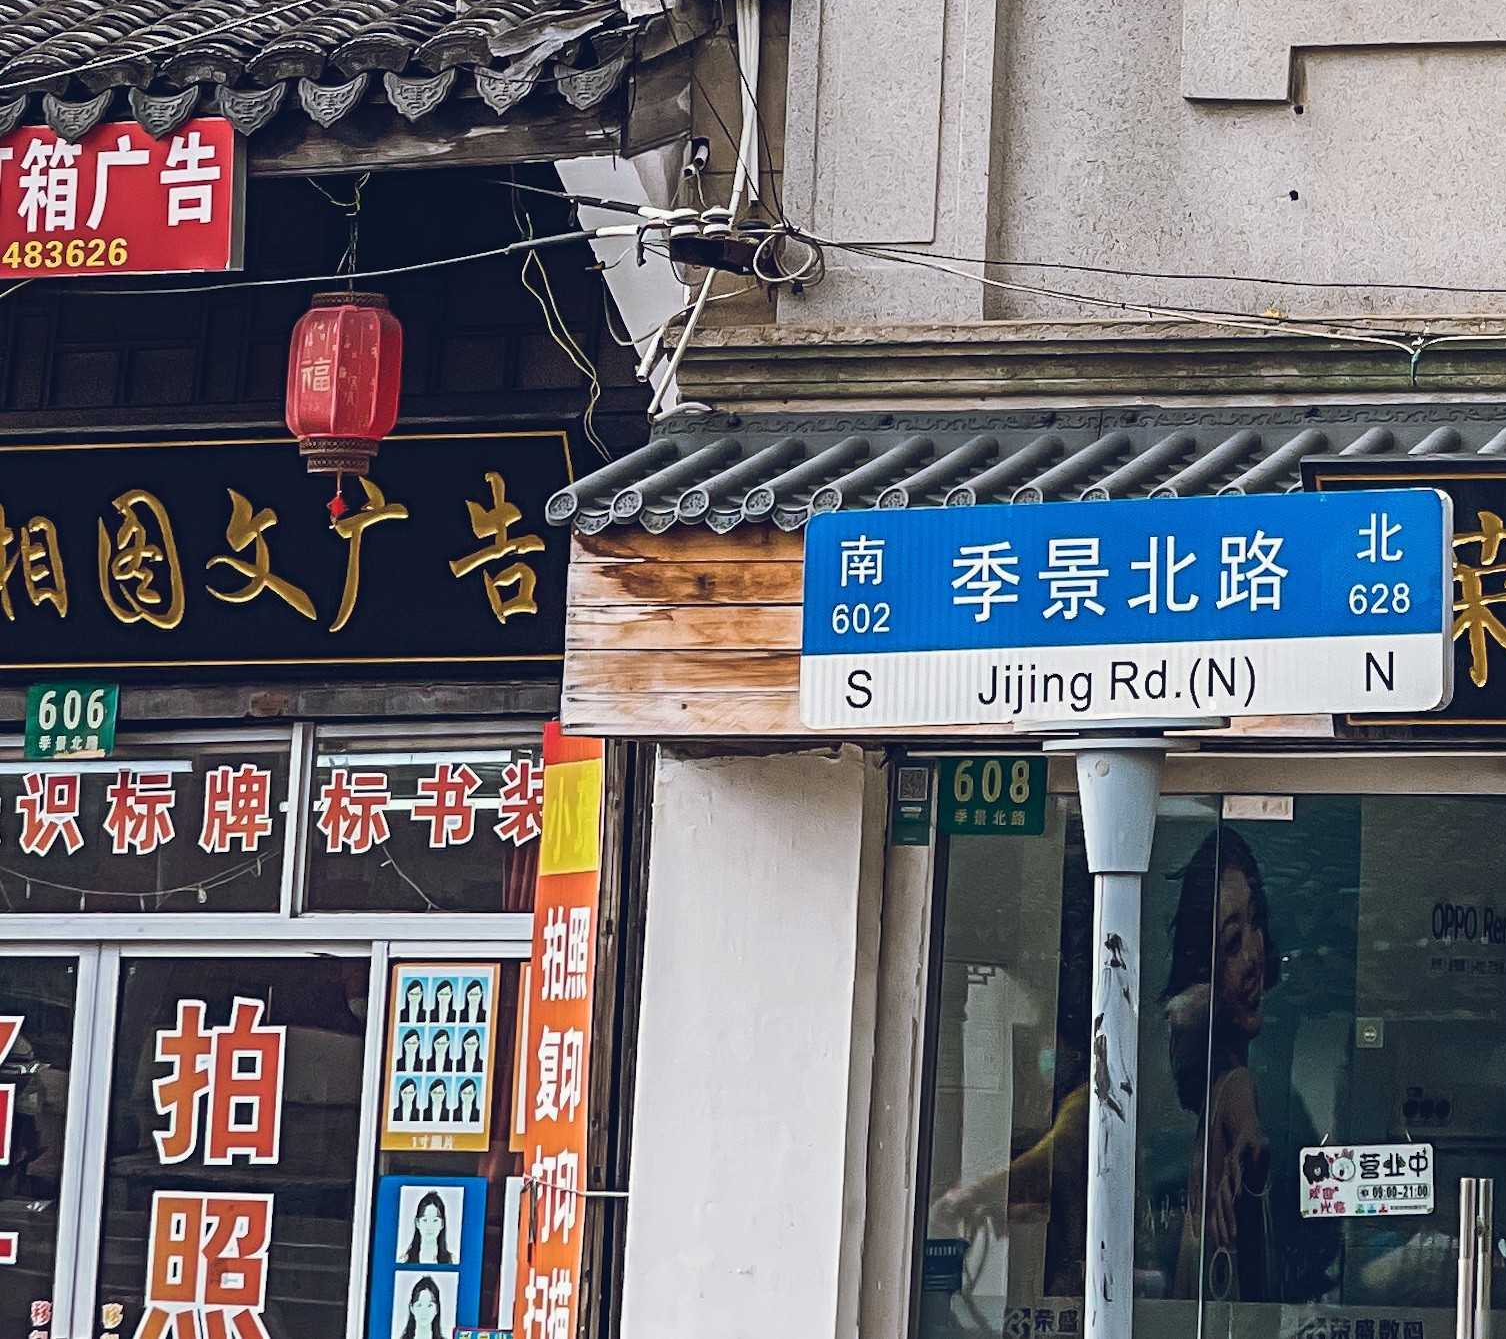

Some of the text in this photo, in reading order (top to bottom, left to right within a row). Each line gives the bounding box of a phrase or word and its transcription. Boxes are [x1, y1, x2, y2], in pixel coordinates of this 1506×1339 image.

[0, 132, 221, 233] 箱广告
[2, 238, 128, 268] 483626
[840, 511, 1403, 624] 南 季景北路 北
[832, 582, 1411, 635] 602 628
[38, 689, 105, 730] 606
[846, 650, 1396, 715] S Jijing Rd.(N) N
[953, 760, 1030, 803] 608
[541, 906, 590, 1001] 拍照
[1432, 903, 1477, 940] OPPO
[535, 1025, 584, 1122] 复印
[130, 995, 287, 1339] 拍照
[528, 1144, 579, 1244] 打印
[1359, 1148, 1429, 1179] 营业中
